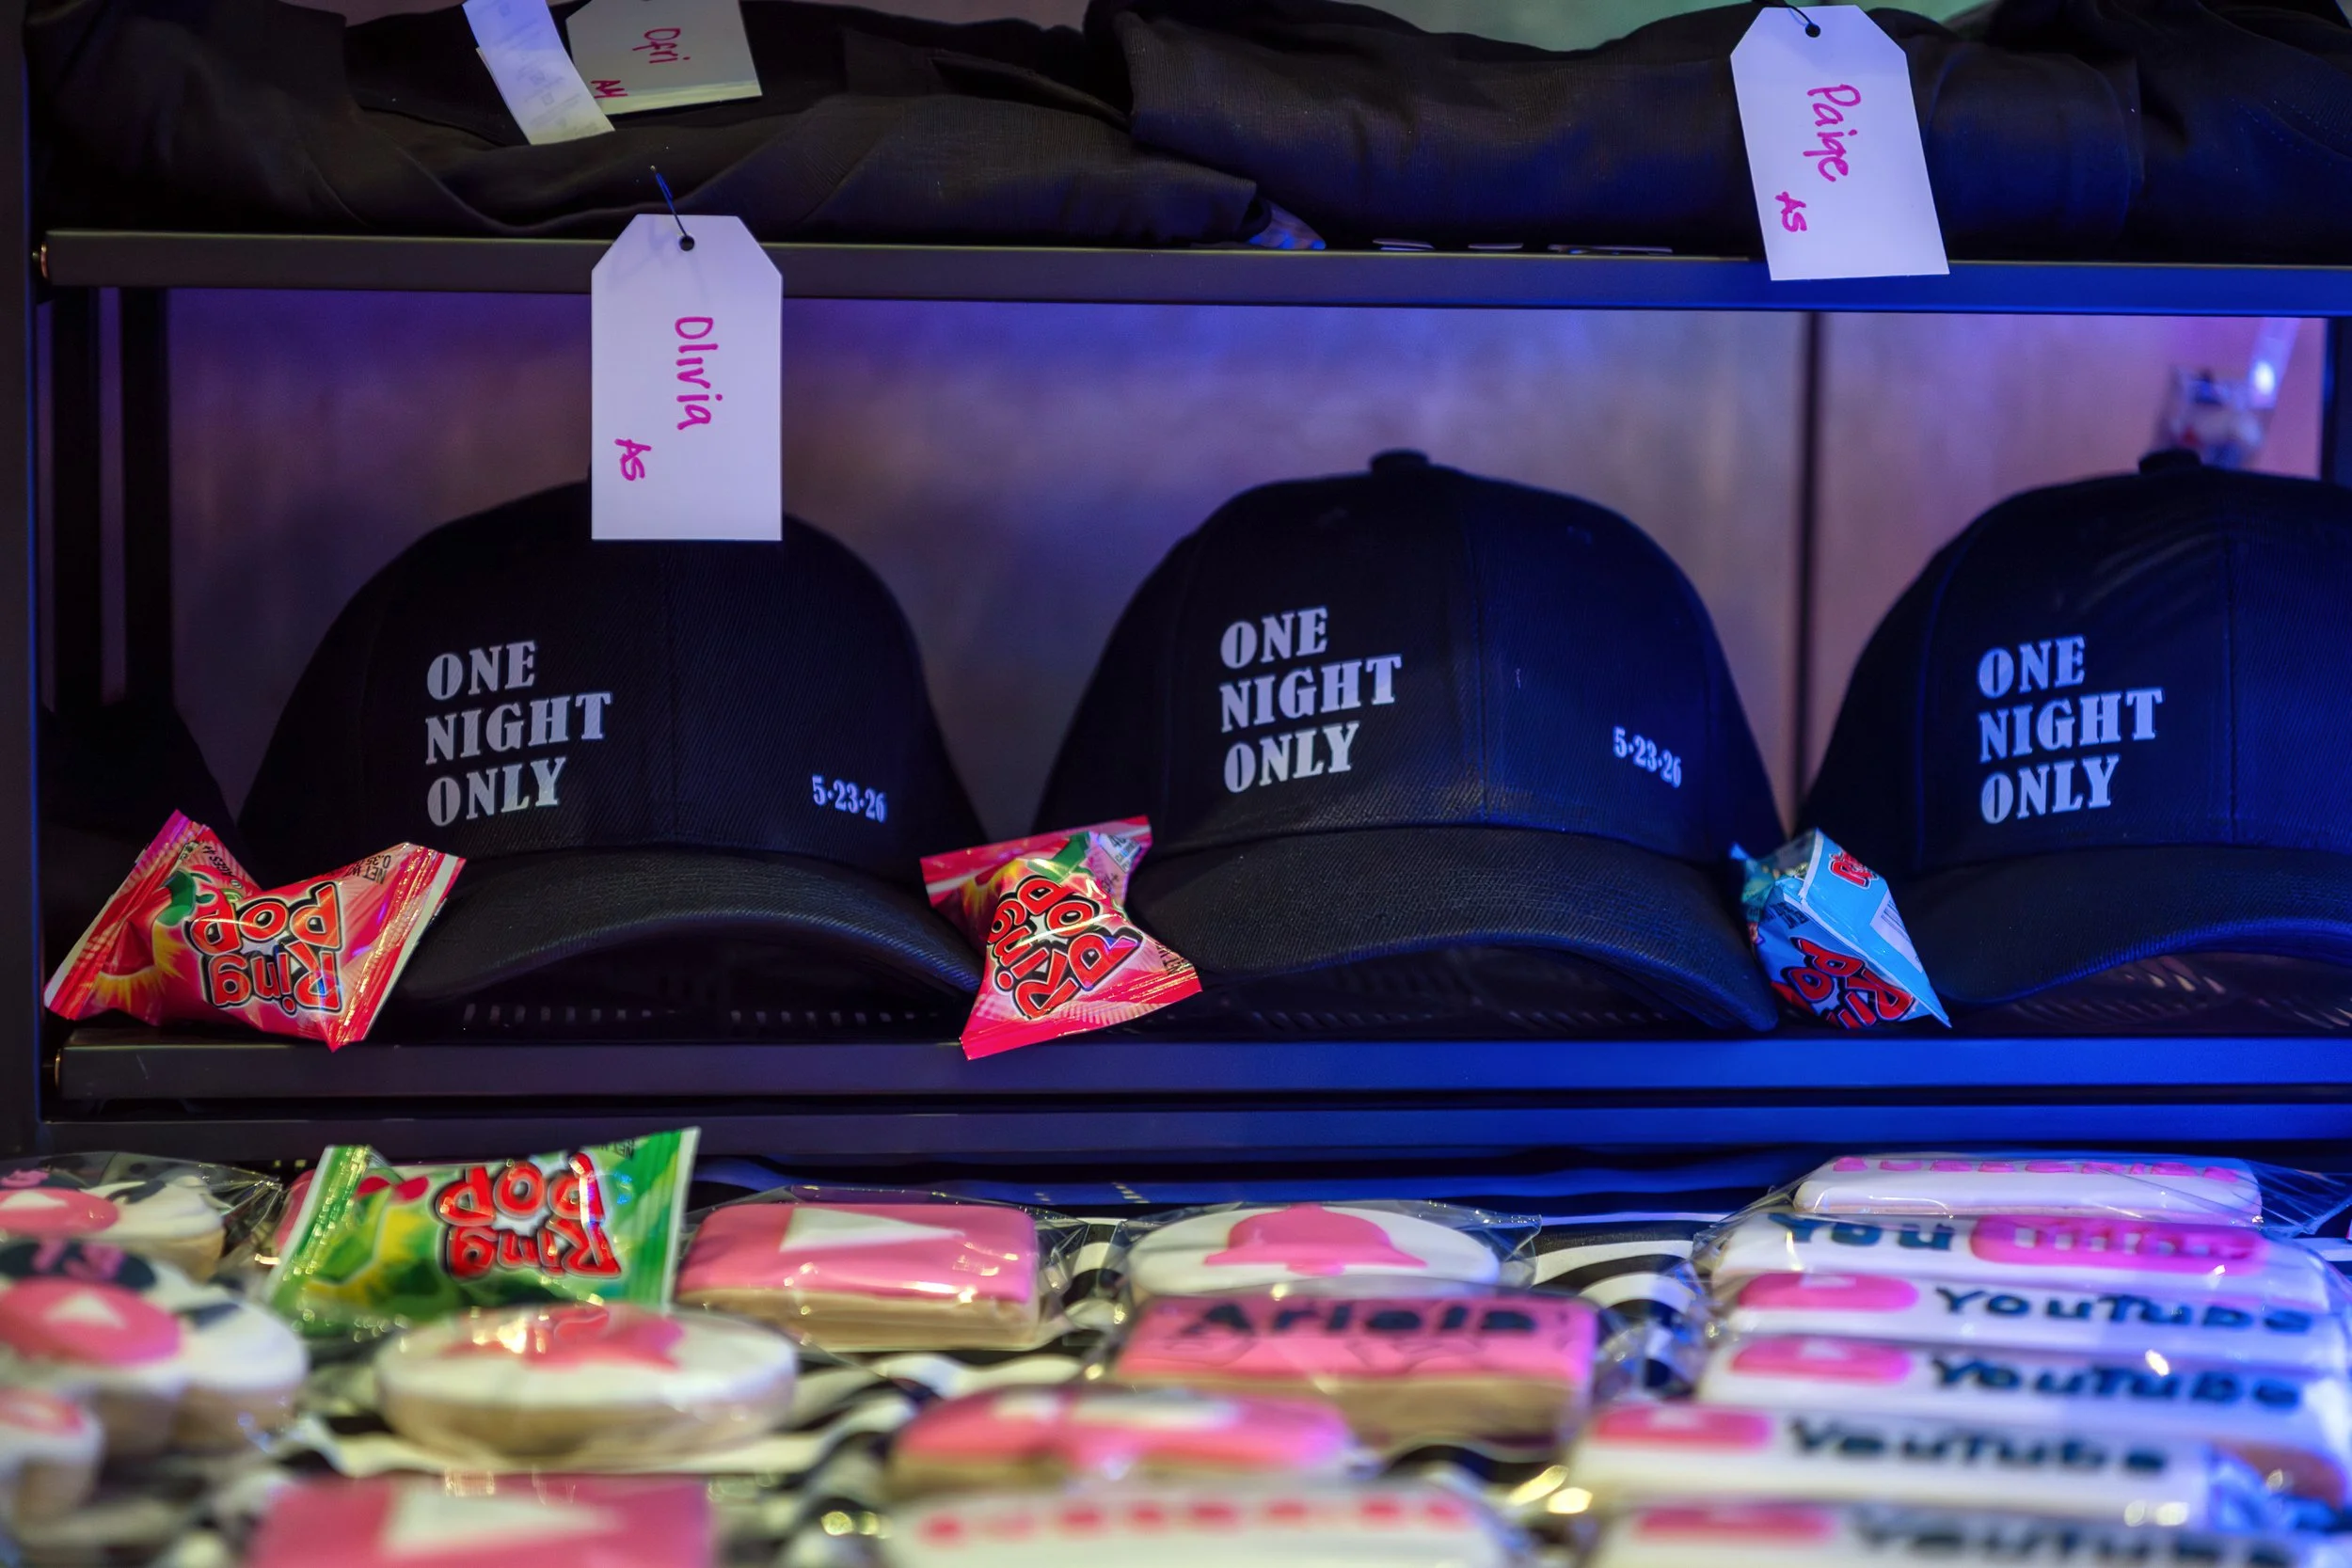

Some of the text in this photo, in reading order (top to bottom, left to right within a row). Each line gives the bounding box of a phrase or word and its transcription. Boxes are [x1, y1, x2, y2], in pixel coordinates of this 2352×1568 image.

[632, 27, 691, 64] Ofri
[1803, 84, 1862, 182] Paige
[1774, 191, 1807, 232] AS
[675, 316, 723, 431] Olivia
[613, 437, 652, 481] AS
[426, 641, 536, 701] ONE
[1220, 606, 1328, 669] ONE
[1978, 634, 2086, 700] ONE
[425, 691, 613, 765] NIGHT
[1219, 654, 1403, 733] NIGHT
[1979, 688, 2165, 765] NIGHT
[427, 757, 566, 827] ONLY
[1224, 721, 1360, 793] ONLY
[1980, 753, 2121, 825] ONLY
[361, 864, 388, 885] NET
[202, 939, 342, 1014] Ring
[988, 896, 1079, 1021] Ring
[443, 1218, 622, 1279] Ring
